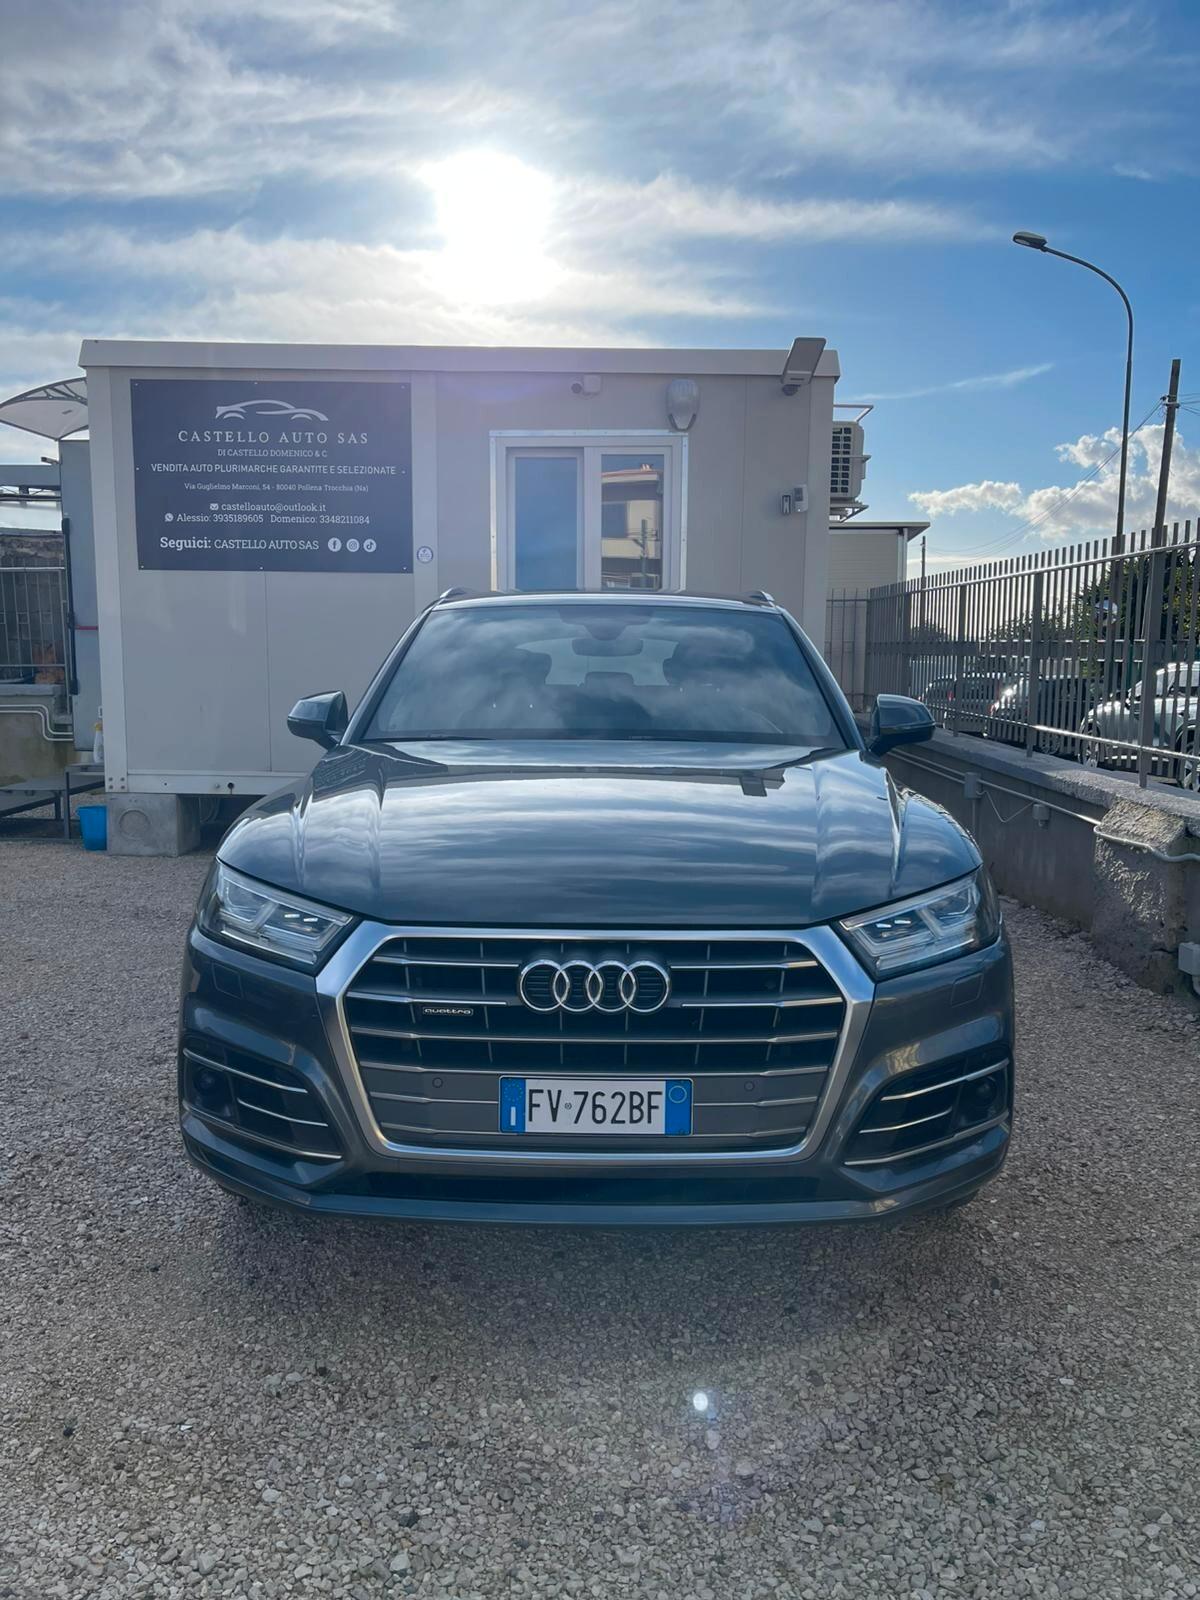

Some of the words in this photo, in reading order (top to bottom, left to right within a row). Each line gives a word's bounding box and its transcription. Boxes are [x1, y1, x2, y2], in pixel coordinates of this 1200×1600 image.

[178, 431, 270, 443] CASTELLO
[279, 432, 328, 444] AUTO
[338, 433, 368, 444] SAS
[151, 464, 190, 472] VENDITA
[191, 464, 213, 472] AUTO
[215, 464, 278, 473] PLURIMARCHE
[280, 465, 328, 473] GARANTITE
[337, 466, 396, 475] SELEZIONATE
[196, 483, 230, 492] Guglielmo
[221, 503, 326, 512] castelloauto@outlook.it
[177, 514, 211, 522] Alessio:
[213, 514, 263, 523] 3935189605
[270, 514, 318, 524] Domenico:
[320, 515, 370, 524] 3348211084
[160, 537, 211, 551] Seguici:
[214, 540, 267, 549] CASTELLO
[268, 540, 298, 550] AUTO
[299, 540, 319, 550] SAS
